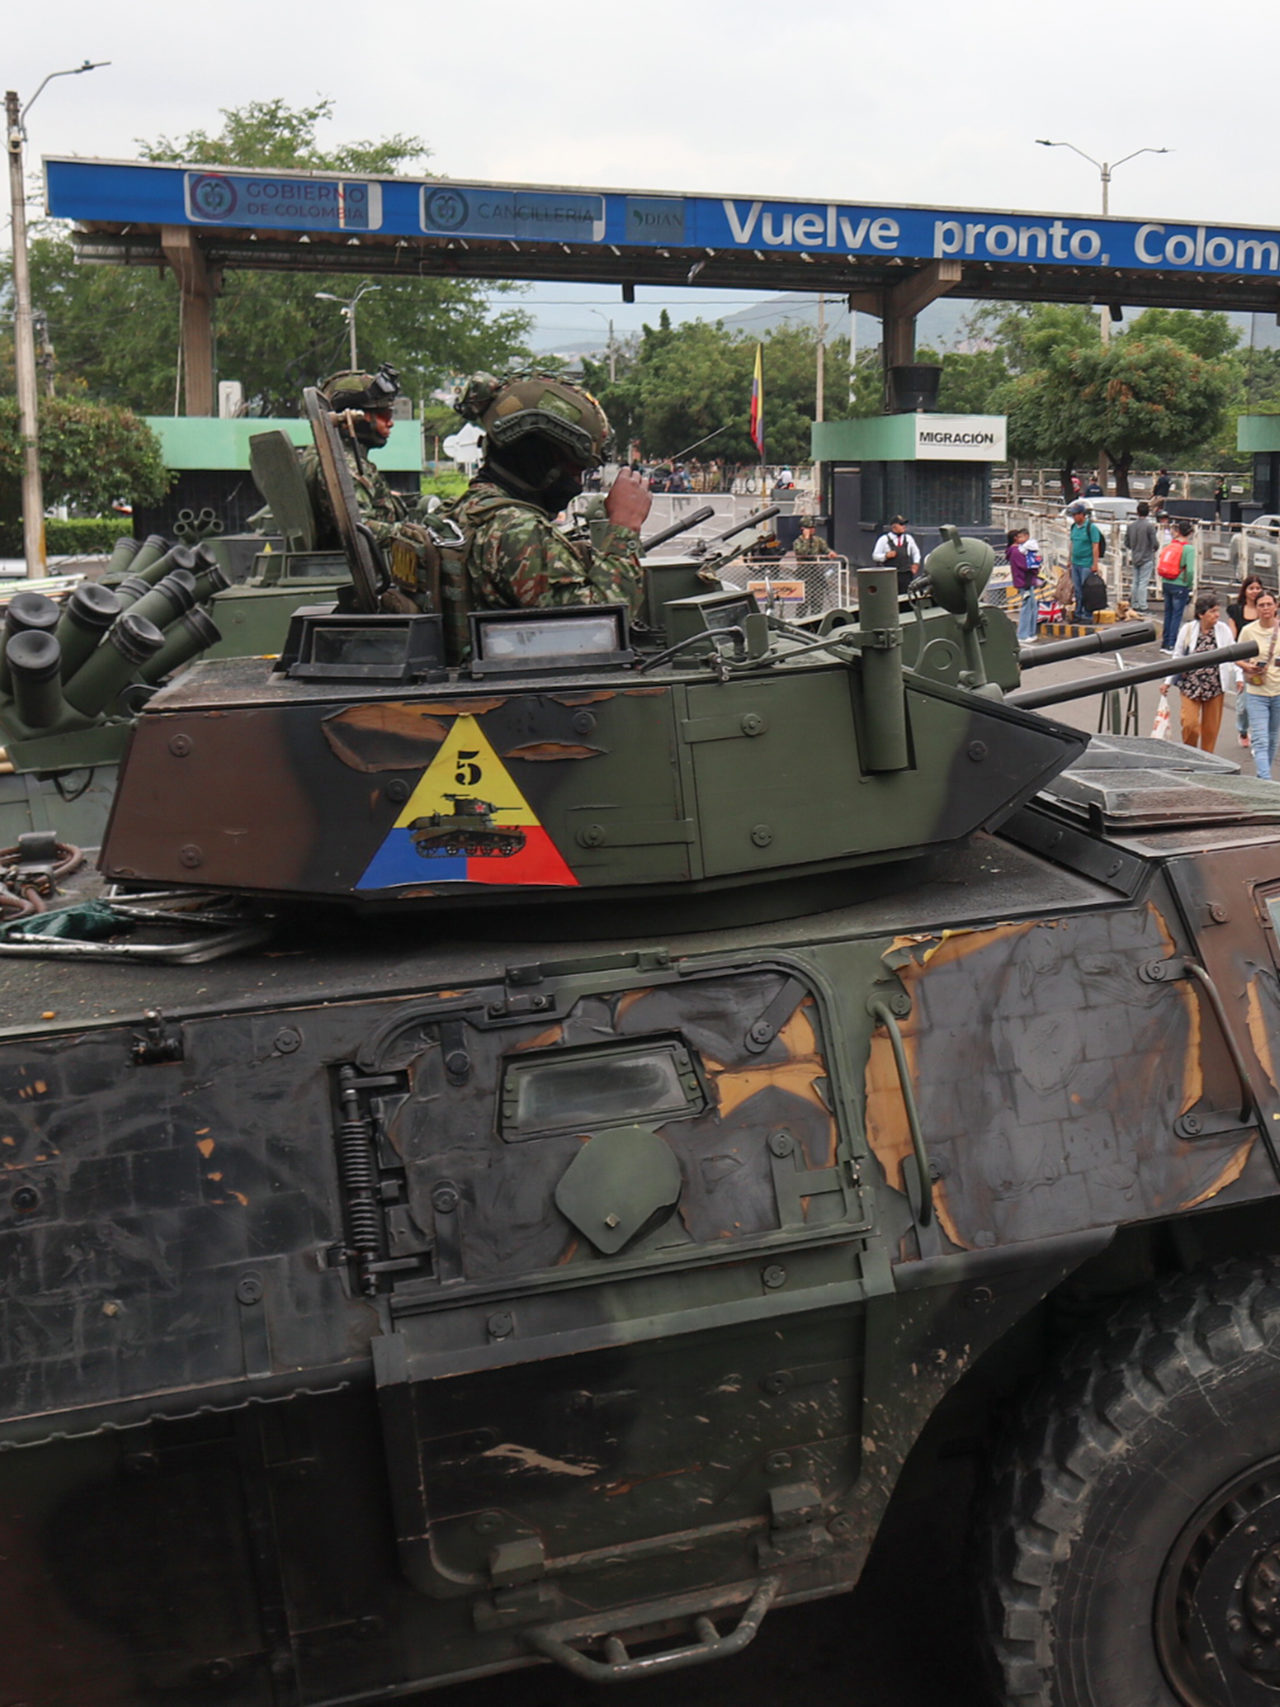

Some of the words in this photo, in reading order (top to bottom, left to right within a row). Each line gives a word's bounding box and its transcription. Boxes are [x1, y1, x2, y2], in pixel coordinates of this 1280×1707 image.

[246, 182, 365, 203] GOBIERNO
[247, 203, 269, 216] DE
[274, 204, 364, 220] COLOMBIA
[643, 210, 684, 227] DIAN
[722, 200, 900, 250] Vuelve
[933, 219, 1110, 266] pronto,
[454, 750, 482, 786] 5
